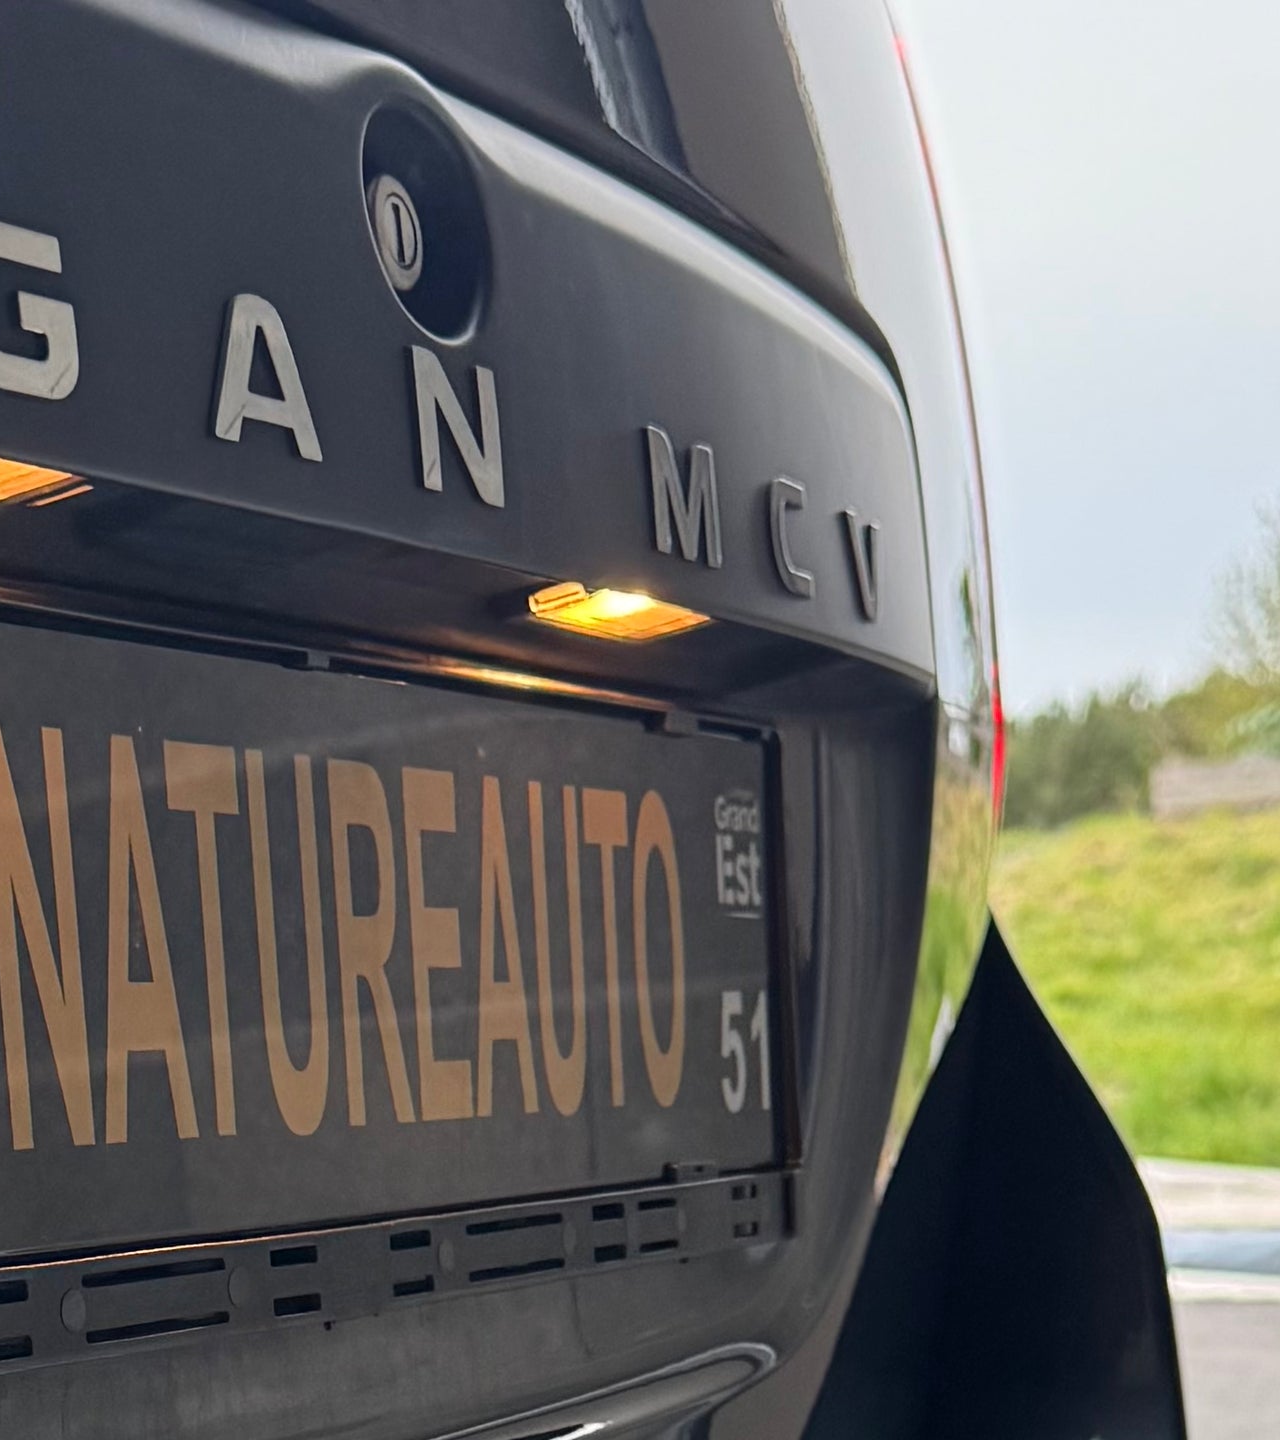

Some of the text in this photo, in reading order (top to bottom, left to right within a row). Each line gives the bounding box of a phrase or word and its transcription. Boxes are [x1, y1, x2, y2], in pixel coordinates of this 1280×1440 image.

[644, 422, 883, 622] MCV
[713, 796, 760, 833] Grand
[716, 834, 762, 906] Est
[721, 990, 771, 1114] 51
